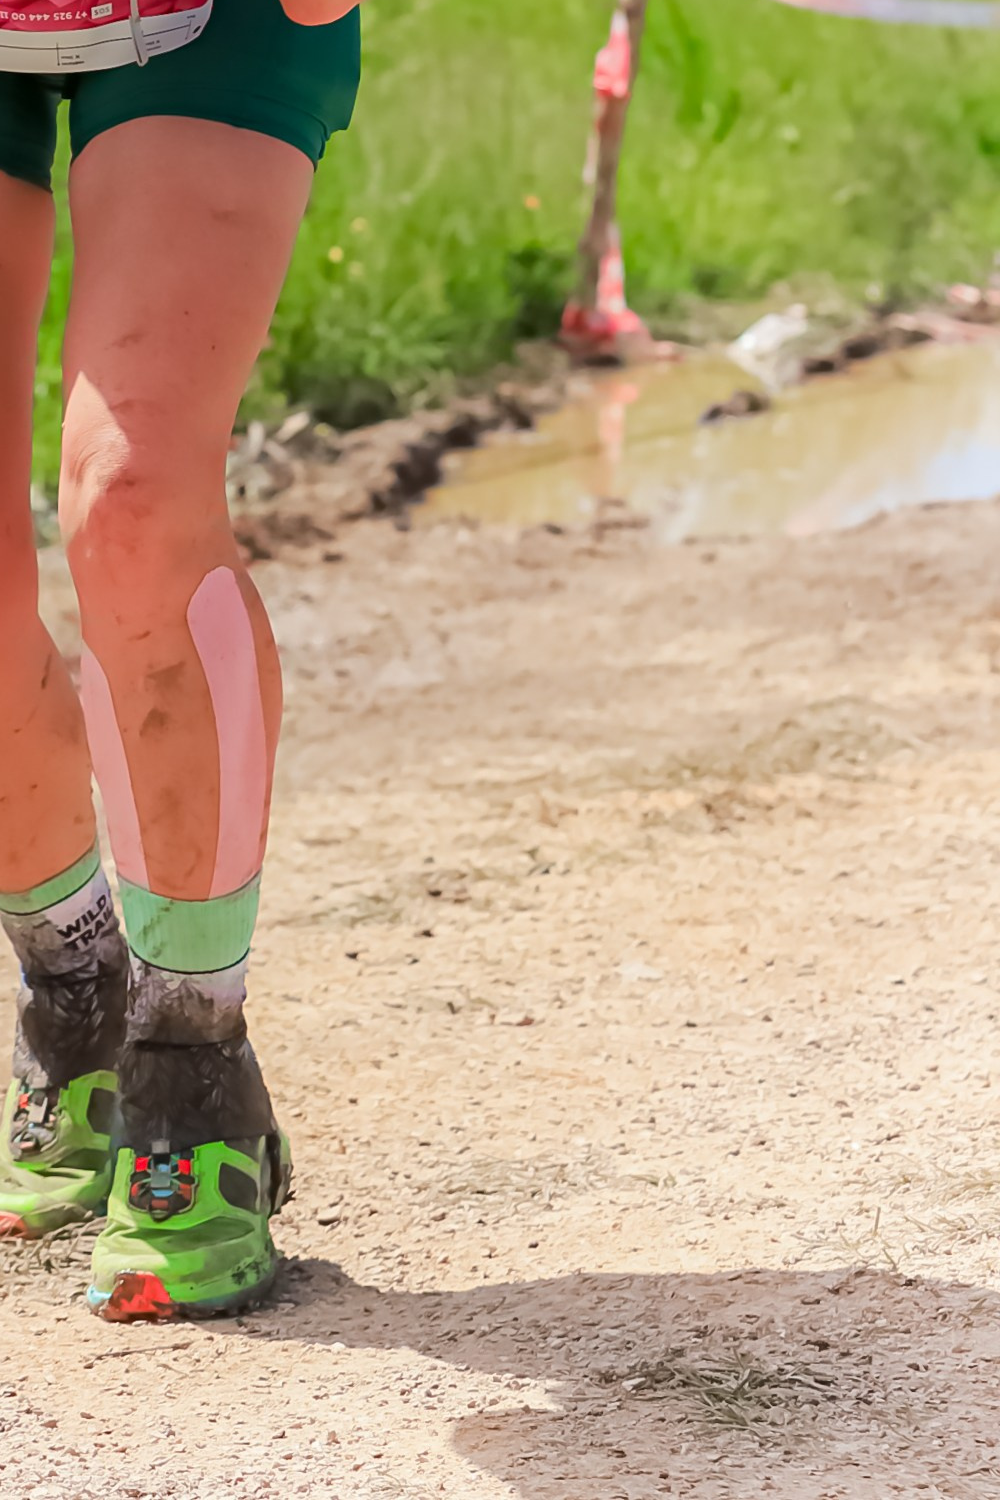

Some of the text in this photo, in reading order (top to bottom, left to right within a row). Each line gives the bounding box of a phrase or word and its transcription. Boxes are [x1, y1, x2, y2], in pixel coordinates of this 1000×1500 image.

[75, 10, 88, 19] +7
[93, 6, 110, 16] SOS
[11, 12, 26, 21] 00
[29, 13, 50, 21] 444
[53, 12, 72, 20] 925
[56, 894, 107, 939] WILD
